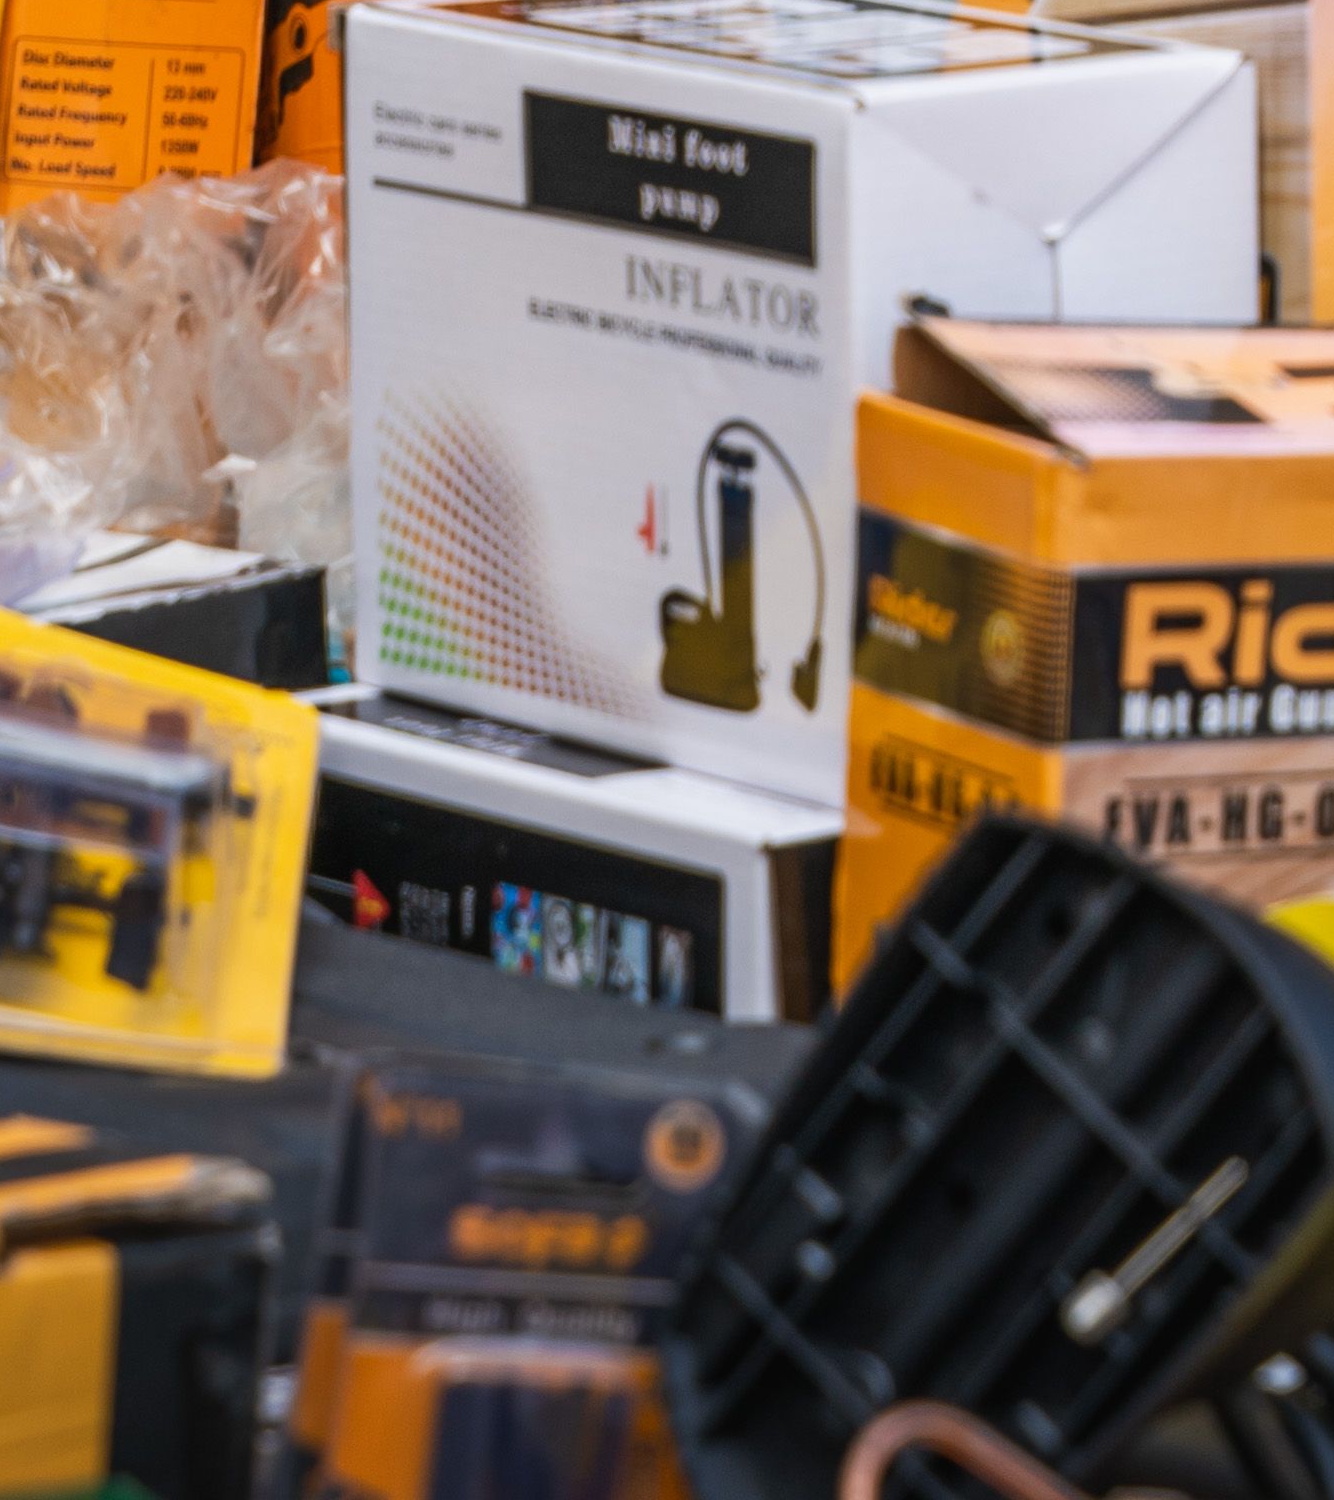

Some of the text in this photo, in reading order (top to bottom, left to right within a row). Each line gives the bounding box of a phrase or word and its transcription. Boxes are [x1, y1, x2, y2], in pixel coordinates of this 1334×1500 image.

[62, 81, 113, 98] Voltage
[607, 116, 750, 178] Mini foot
[639, 181, 721, 231] pump
[624, 253, 822, 338] INFLATOR
[1198, 688, 1263, 737] air
